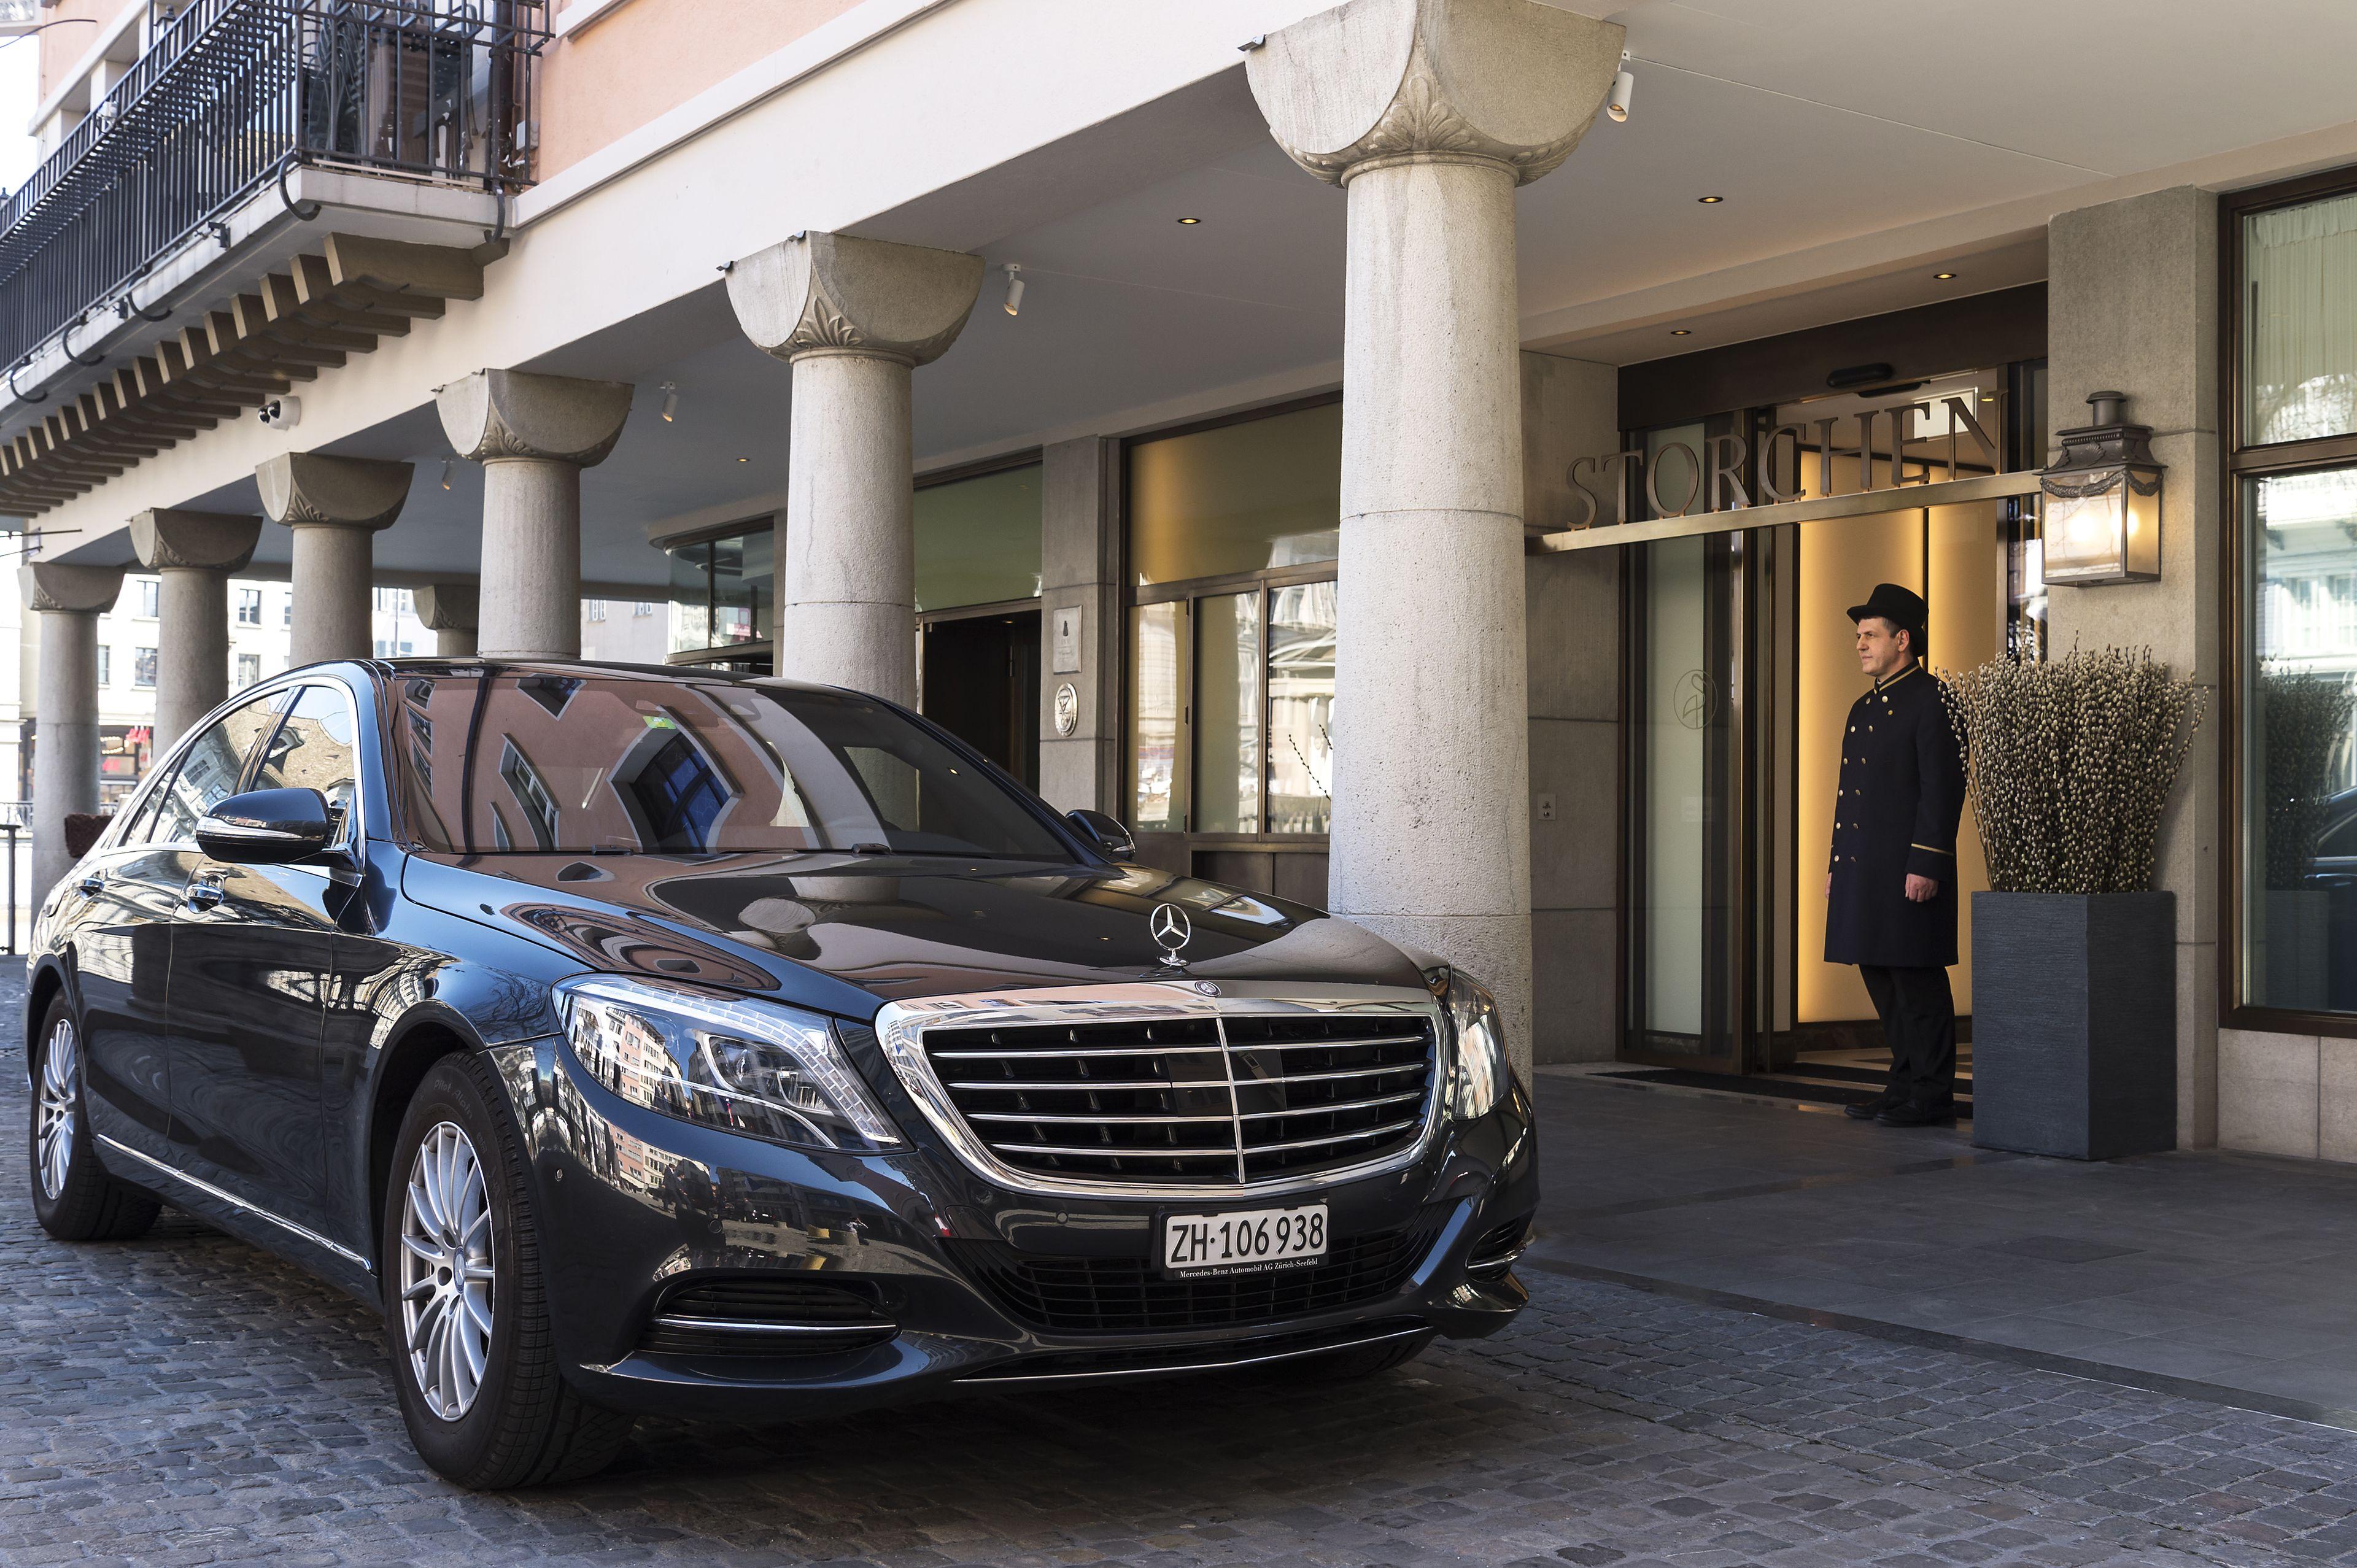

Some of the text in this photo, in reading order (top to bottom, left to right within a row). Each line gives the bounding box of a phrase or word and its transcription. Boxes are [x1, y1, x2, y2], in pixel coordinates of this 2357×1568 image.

[1567, 389, 2009, 528] STORCHEN
[1180, 1269, 1228, 1278] Mercedes-Benz
[1229, 1265, 1263, 1275] Automobil
